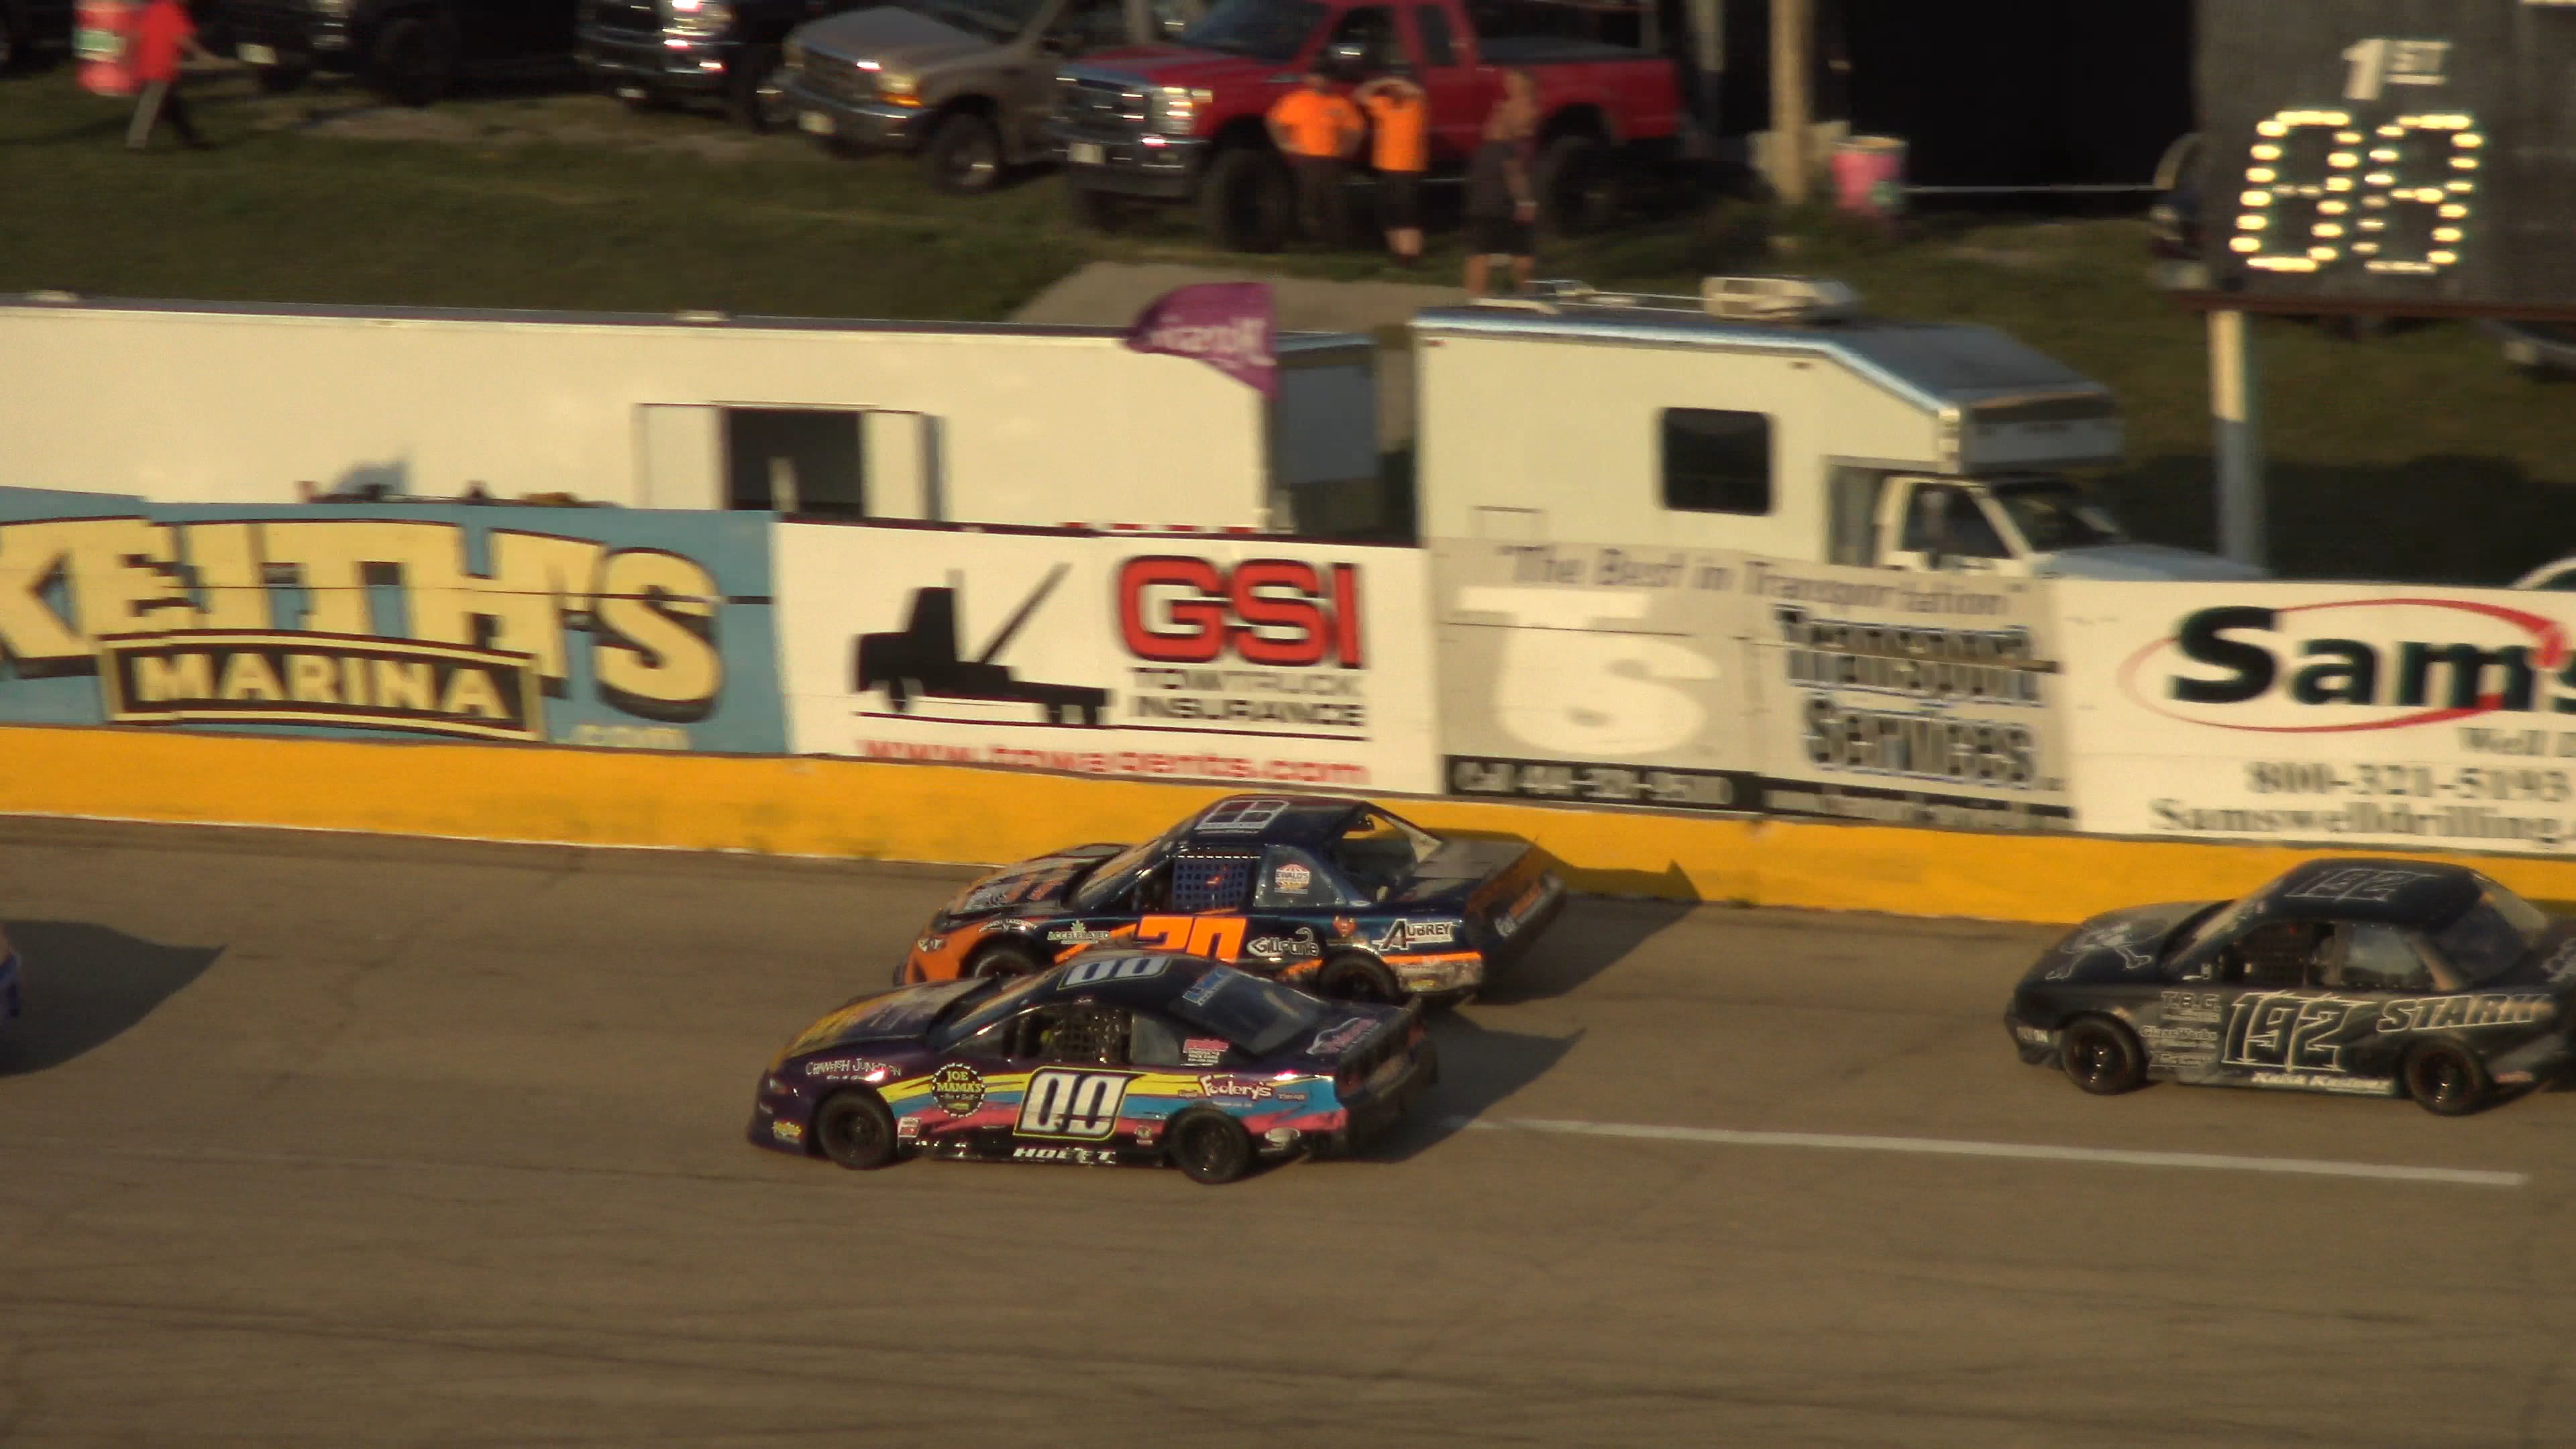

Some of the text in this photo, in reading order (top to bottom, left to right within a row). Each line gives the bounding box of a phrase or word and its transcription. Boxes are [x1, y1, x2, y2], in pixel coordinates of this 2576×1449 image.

[1695, 564, 1736, 592] in
[1117, 555, 1366, 669] GSI
[134, 651, 511, 720] MARINA
[1132, 694, 1367, 729] INSURANCE
[1803, 694, 2037, 790] Services
[1374, 918, 1453, 952] AUBREY
[1064, 957, 1170, 986] 00
[2221, 990, 2377, 1073] 192
[936, 1081, 982, 1093] MAMA'S
[947, 1071, 968, 1082] JOE
[1020, 1072, 1128, 1134] 00
